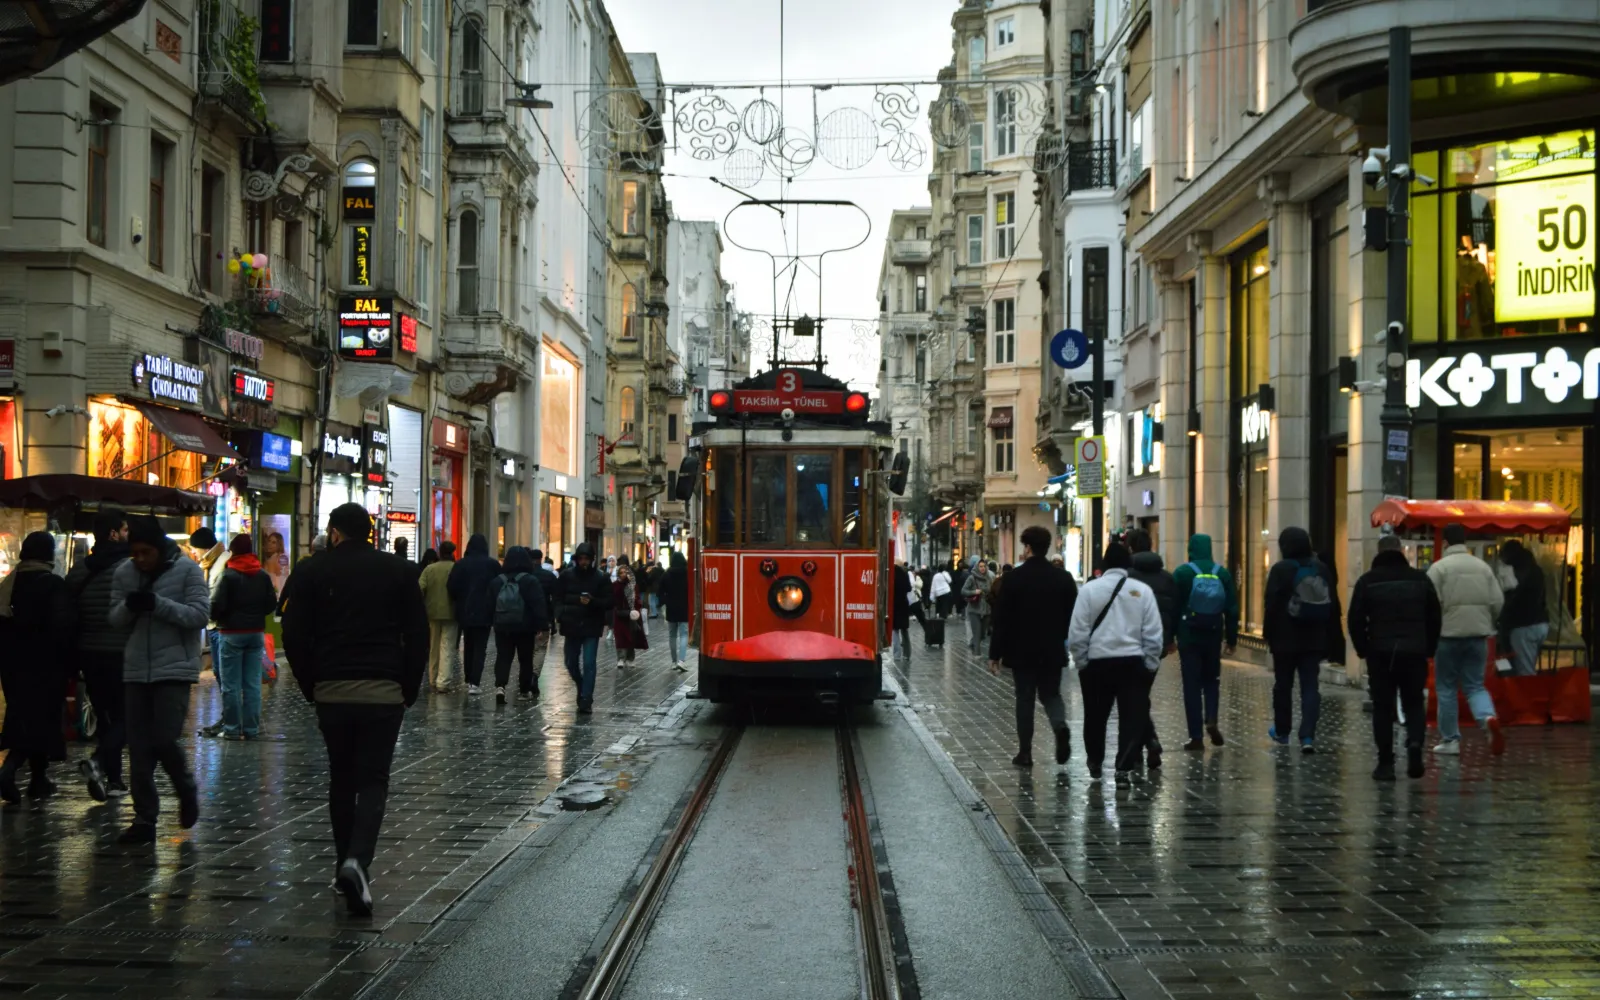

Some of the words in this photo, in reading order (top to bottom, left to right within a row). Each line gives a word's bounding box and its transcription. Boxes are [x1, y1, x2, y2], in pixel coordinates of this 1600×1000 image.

[346, 198, 373, 209] FAL
[1538, 204, 1586, 252] 50
[355, 299, 380, 312] FAL
[145, 354, 172, 377] TARİHİ
[174, 362, 204, 385] BEYOĞLU
[244, 375, 267, 400] TATTOO
[782, 372, 796, 392] 3
[740, 396, 779, 406] TAKSİM
[793, 396, 828, 408] TÜNEL
[861, 570, 873, 585] 410
